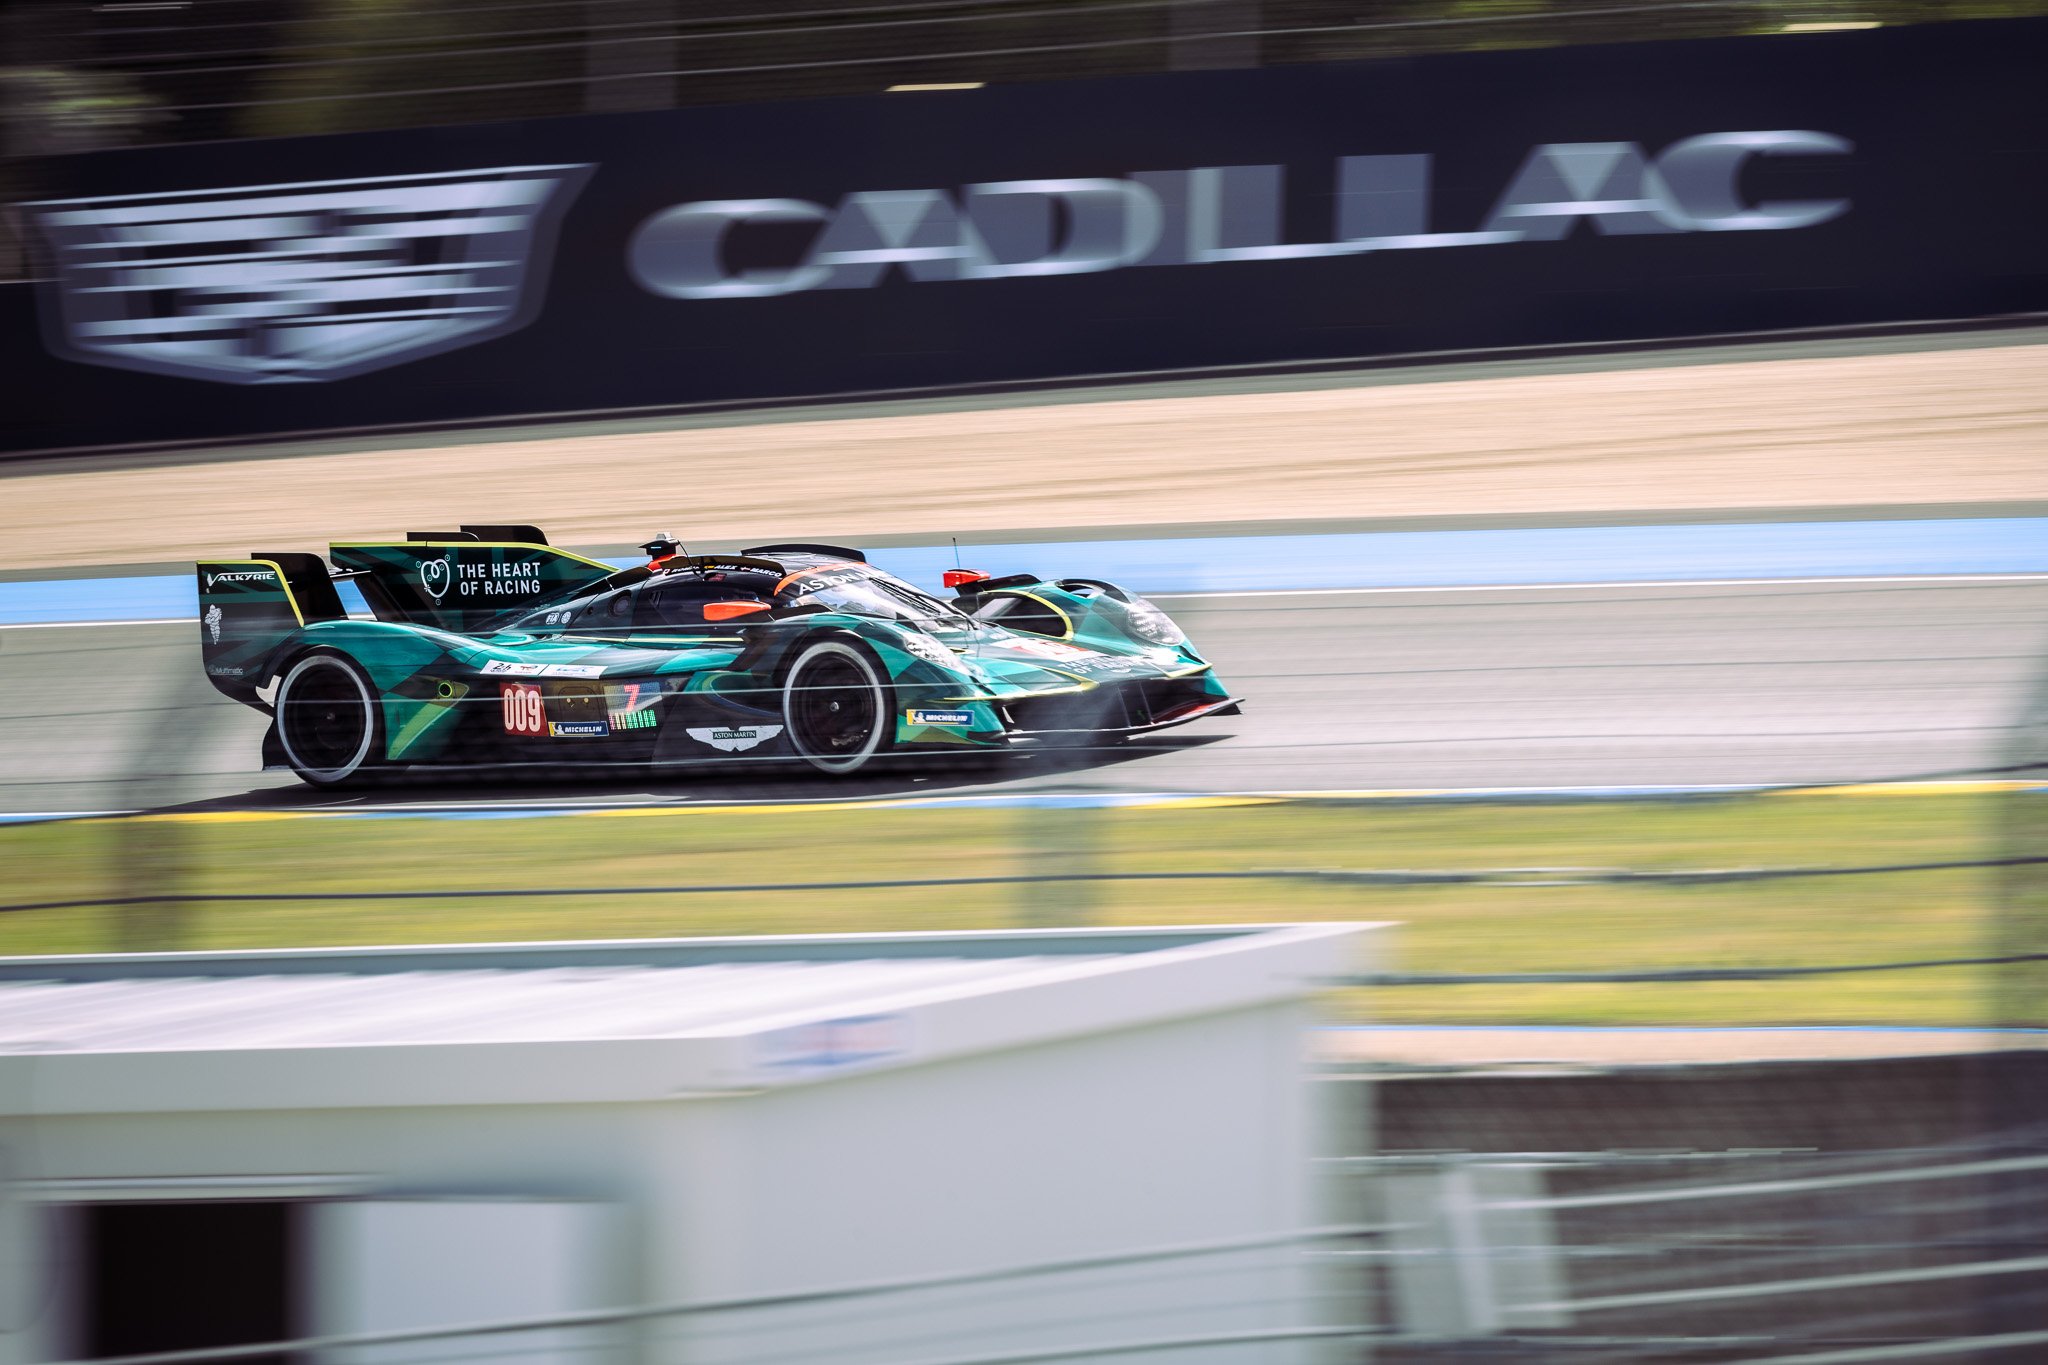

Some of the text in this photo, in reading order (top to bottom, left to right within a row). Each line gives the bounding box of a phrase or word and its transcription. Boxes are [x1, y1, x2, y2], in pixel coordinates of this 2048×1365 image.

[626, 130, 1854, 299] CADILLAC
[457, 562, 541, 578] THE HEART
[750, 567, 782, 577] MARCO
[207, 571, 275, 586] VALKYRIE
[460, 579, 541, 595] OF RACING
[624, 684, 640, 711] 7
[503, 688, 541, 732] 009
